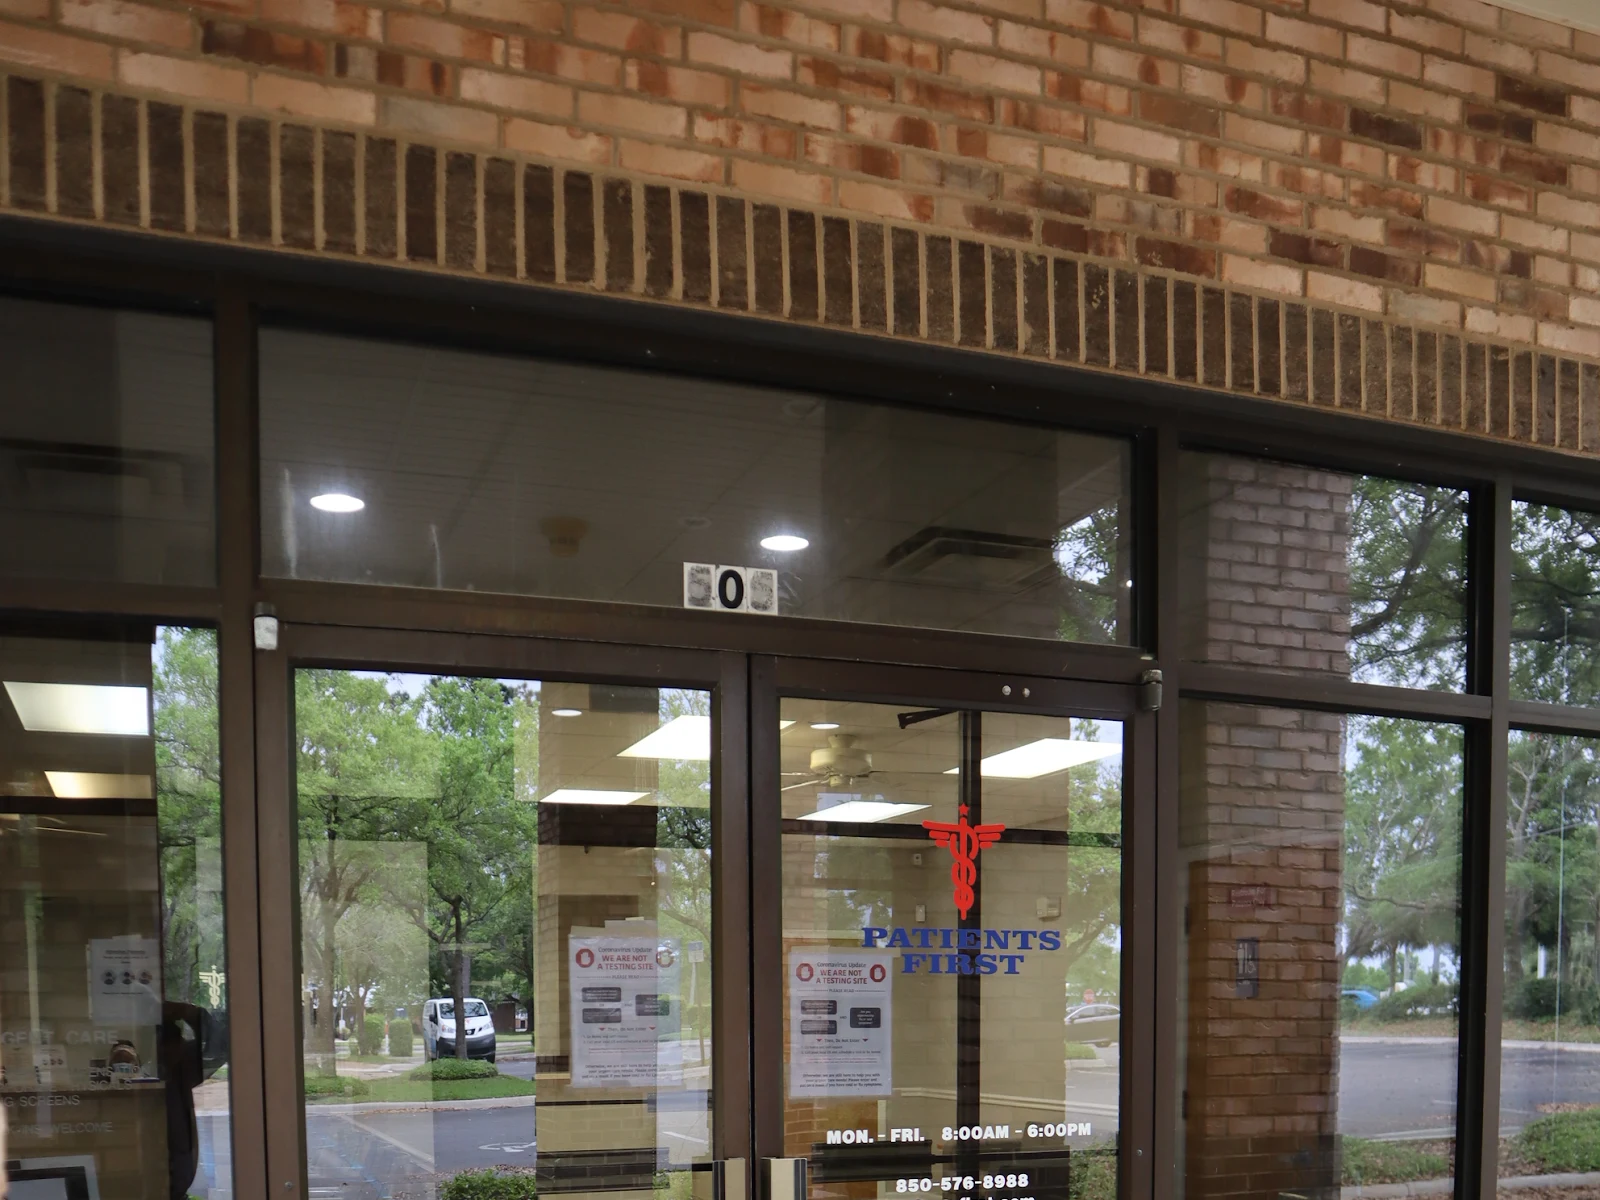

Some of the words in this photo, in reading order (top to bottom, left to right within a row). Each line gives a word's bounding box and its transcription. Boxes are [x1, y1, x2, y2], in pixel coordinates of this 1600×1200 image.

[861, 927, 1061, 950] PATIENTS
[901, 953, 1024, 975] FIRST
[65, 1030, 119, 1045] CARE
[826, 1130, 873, 1144] MON.
[891, 1128, 925, 1142] FRI.
[941, 1125, 1009, 1141] 8:00AM
[1027, 1123, 1091, 1138] 6:00PM
[895, 1174, 1029, 1193] 850-576-8988
